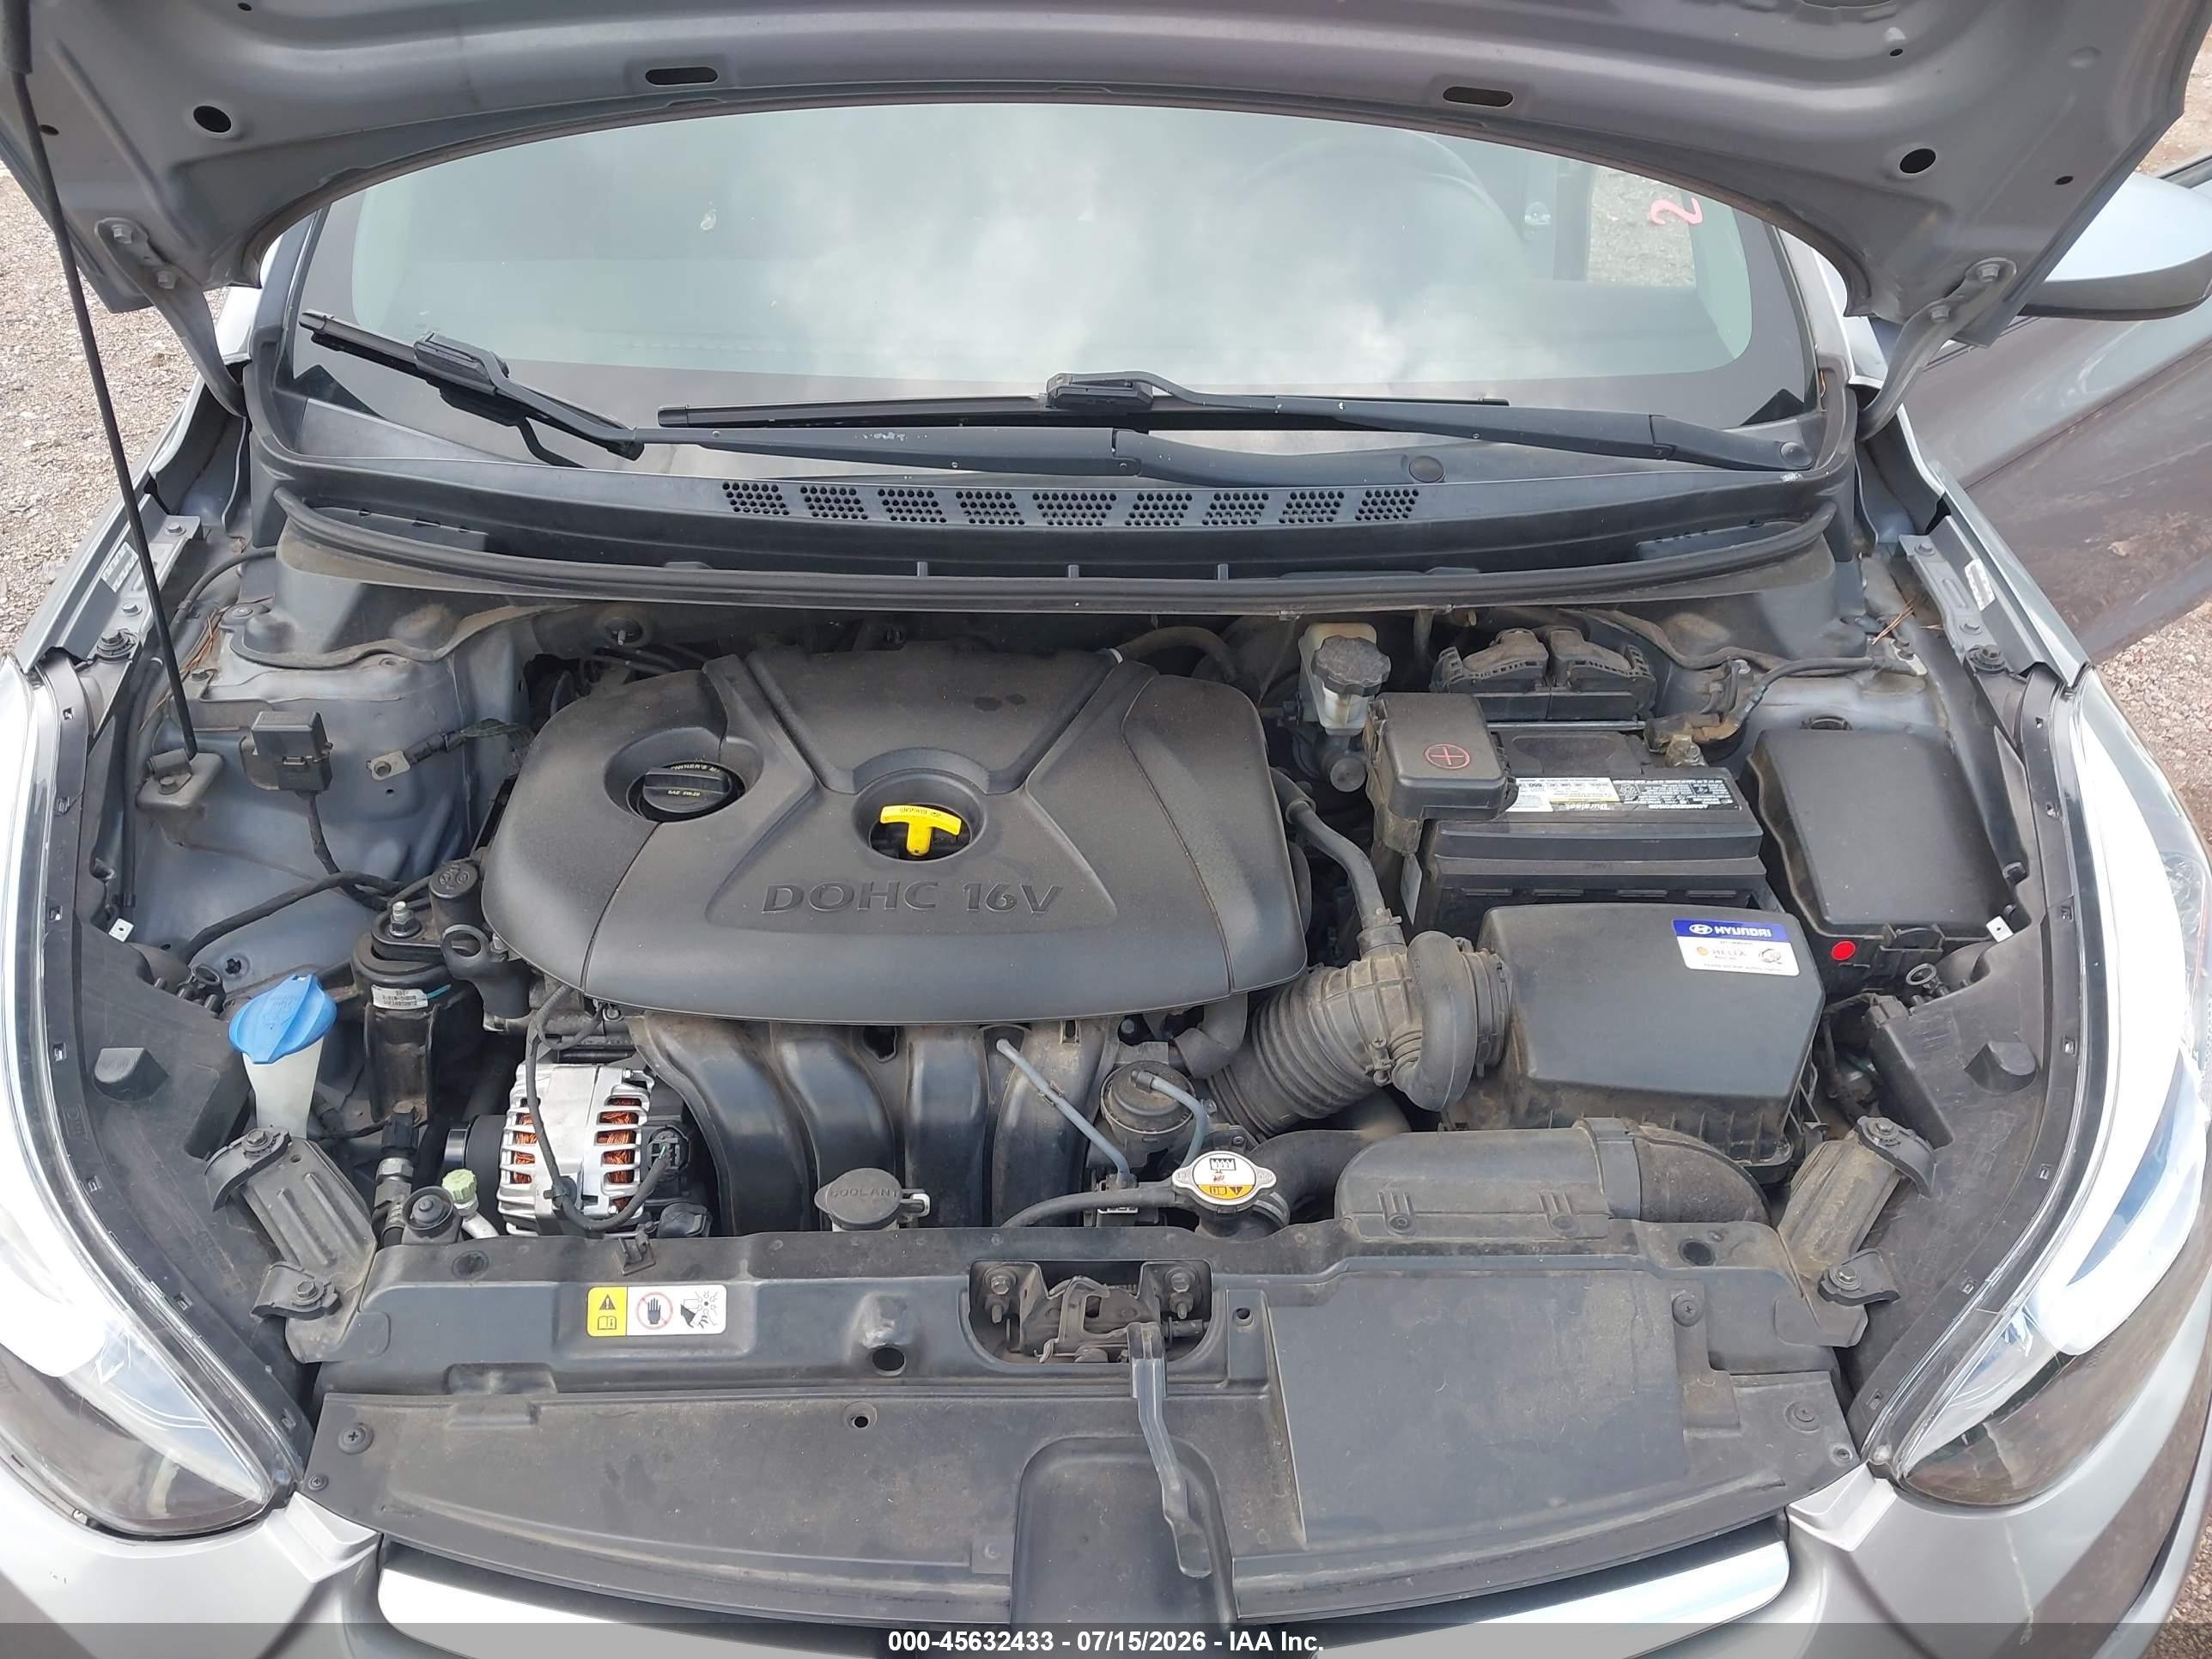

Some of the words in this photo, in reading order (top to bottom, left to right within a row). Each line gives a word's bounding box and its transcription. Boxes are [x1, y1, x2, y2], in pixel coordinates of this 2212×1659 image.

[762, 882, 939, 915] DOHC
[962, 882, 1064, 915] 16V
[1715, 926, 1772, 938] HYUNDAI
[830, 1188, 897, 1198] COOLANT
